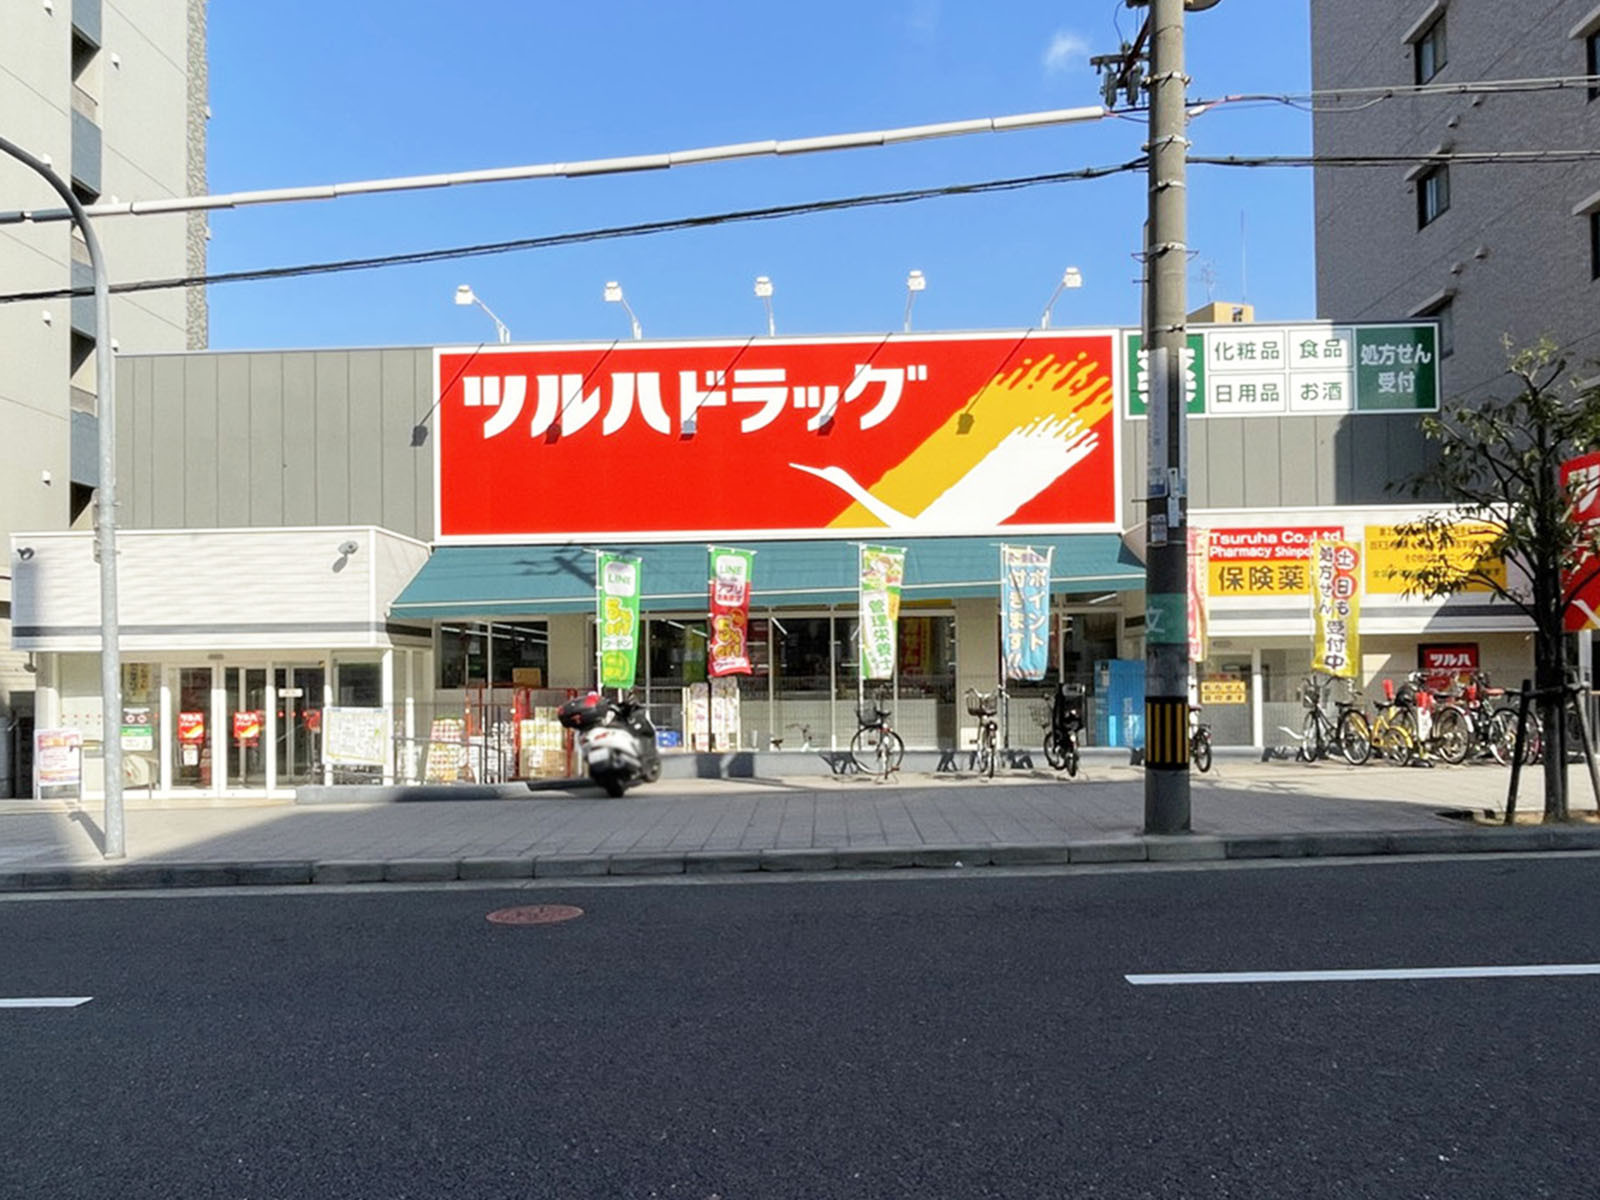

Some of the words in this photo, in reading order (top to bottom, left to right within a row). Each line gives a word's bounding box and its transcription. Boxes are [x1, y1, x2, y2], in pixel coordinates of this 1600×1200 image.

[1214, 341, 1280, 361] 化粧品
[1299, 338, 1343, 360] 食品
[1360, 343, 1432, 366] 処方せん
[1215, 383, 1280, 403] 日用品
[1300, 381, 1343, 402] お酒
[1378, 371, 1416, 394] 受付
[463, 364, 928, 438] ツルハドラッグ
[1210, 532, 1278, 545] Tsuruha
[1209, 547, 1273, 558] Pharmacy
[607, 573, 632, 585] LINE
[1218, 564, 1312, 592] 保険薬
[1336, 547, 1354, 616] 土日も
[1029, 569, 1047, 652] ポイント
[1324, 620, 1347, 669] 受付中
[1429, 653, 1472, 667] ツルハ
